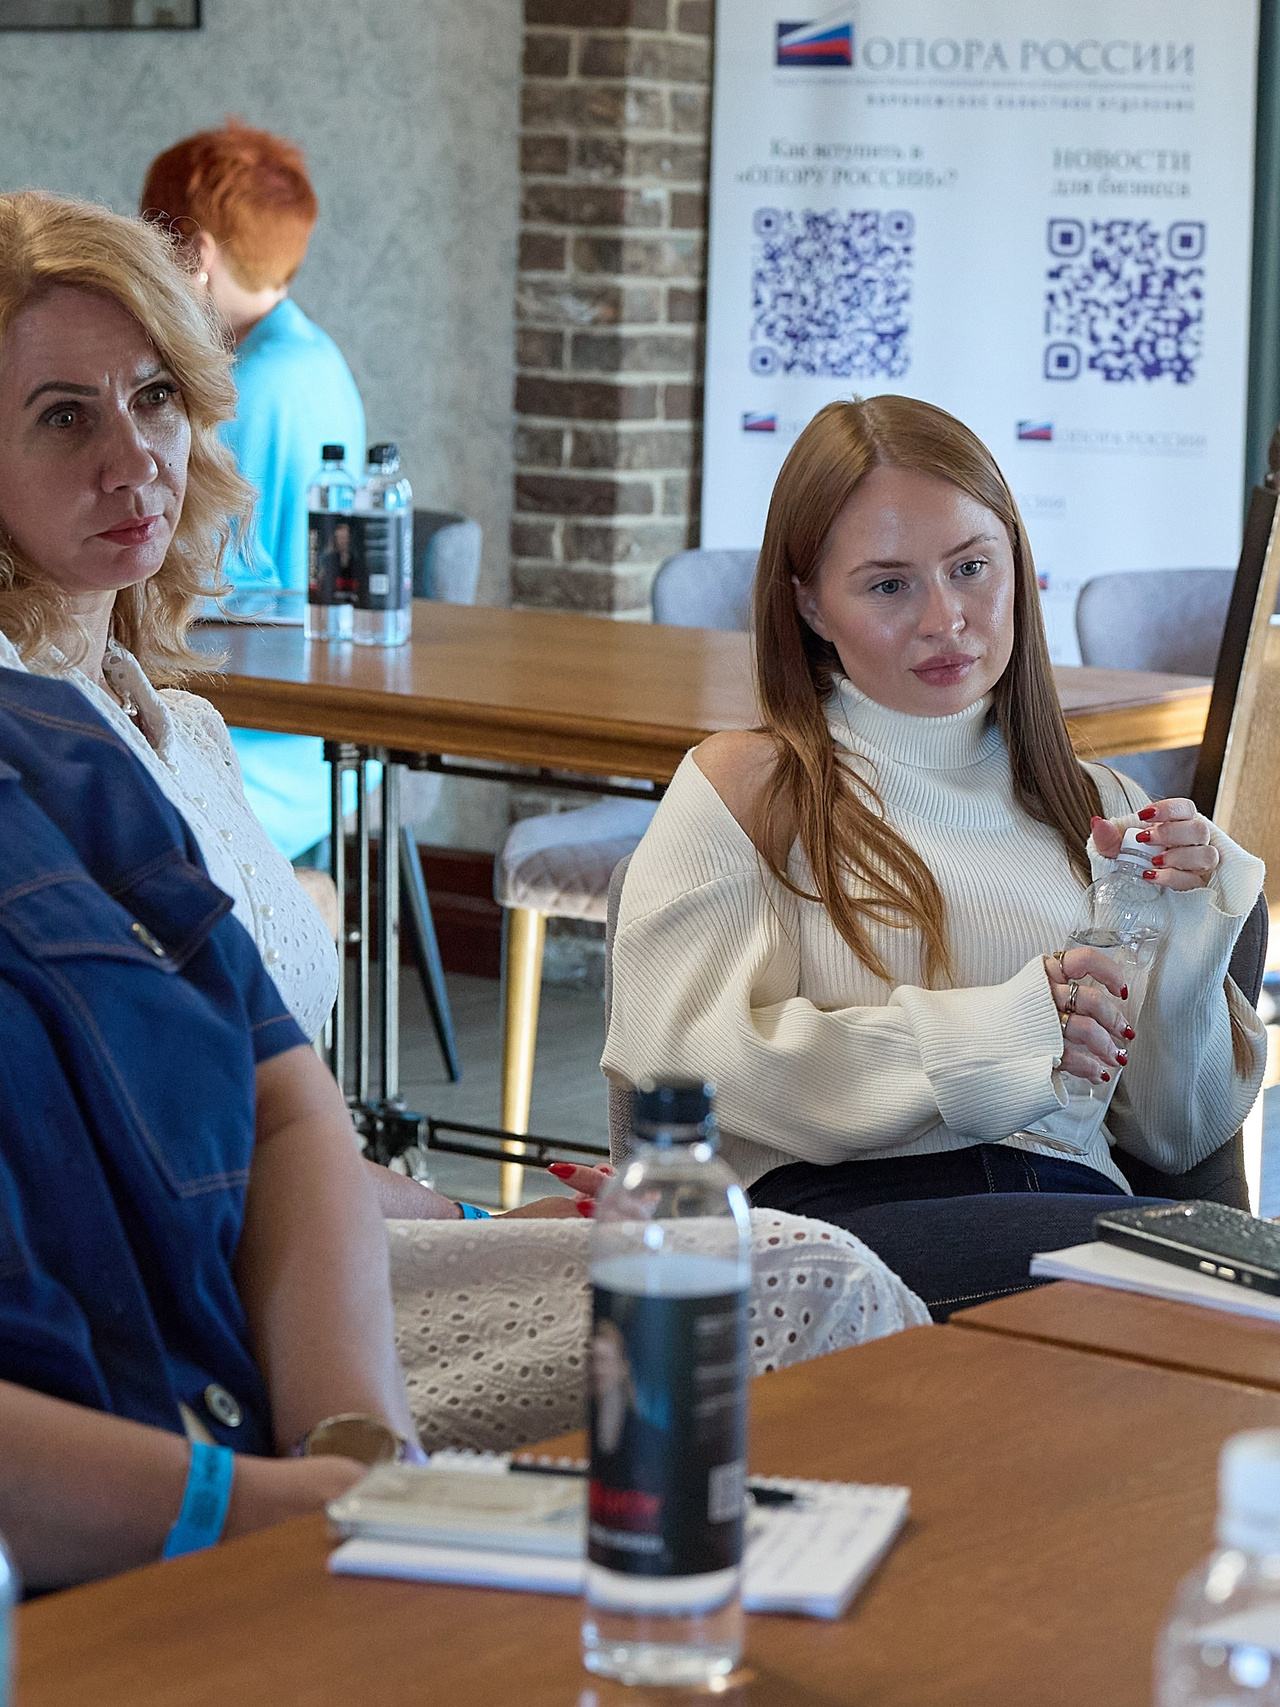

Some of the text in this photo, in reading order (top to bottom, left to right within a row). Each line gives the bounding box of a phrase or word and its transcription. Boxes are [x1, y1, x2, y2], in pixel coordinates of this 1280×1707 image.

[862, 36, 1195, 75] ОПОРА РОССИИ
[1052, 148, 1191, 173] НОВОСТИ
